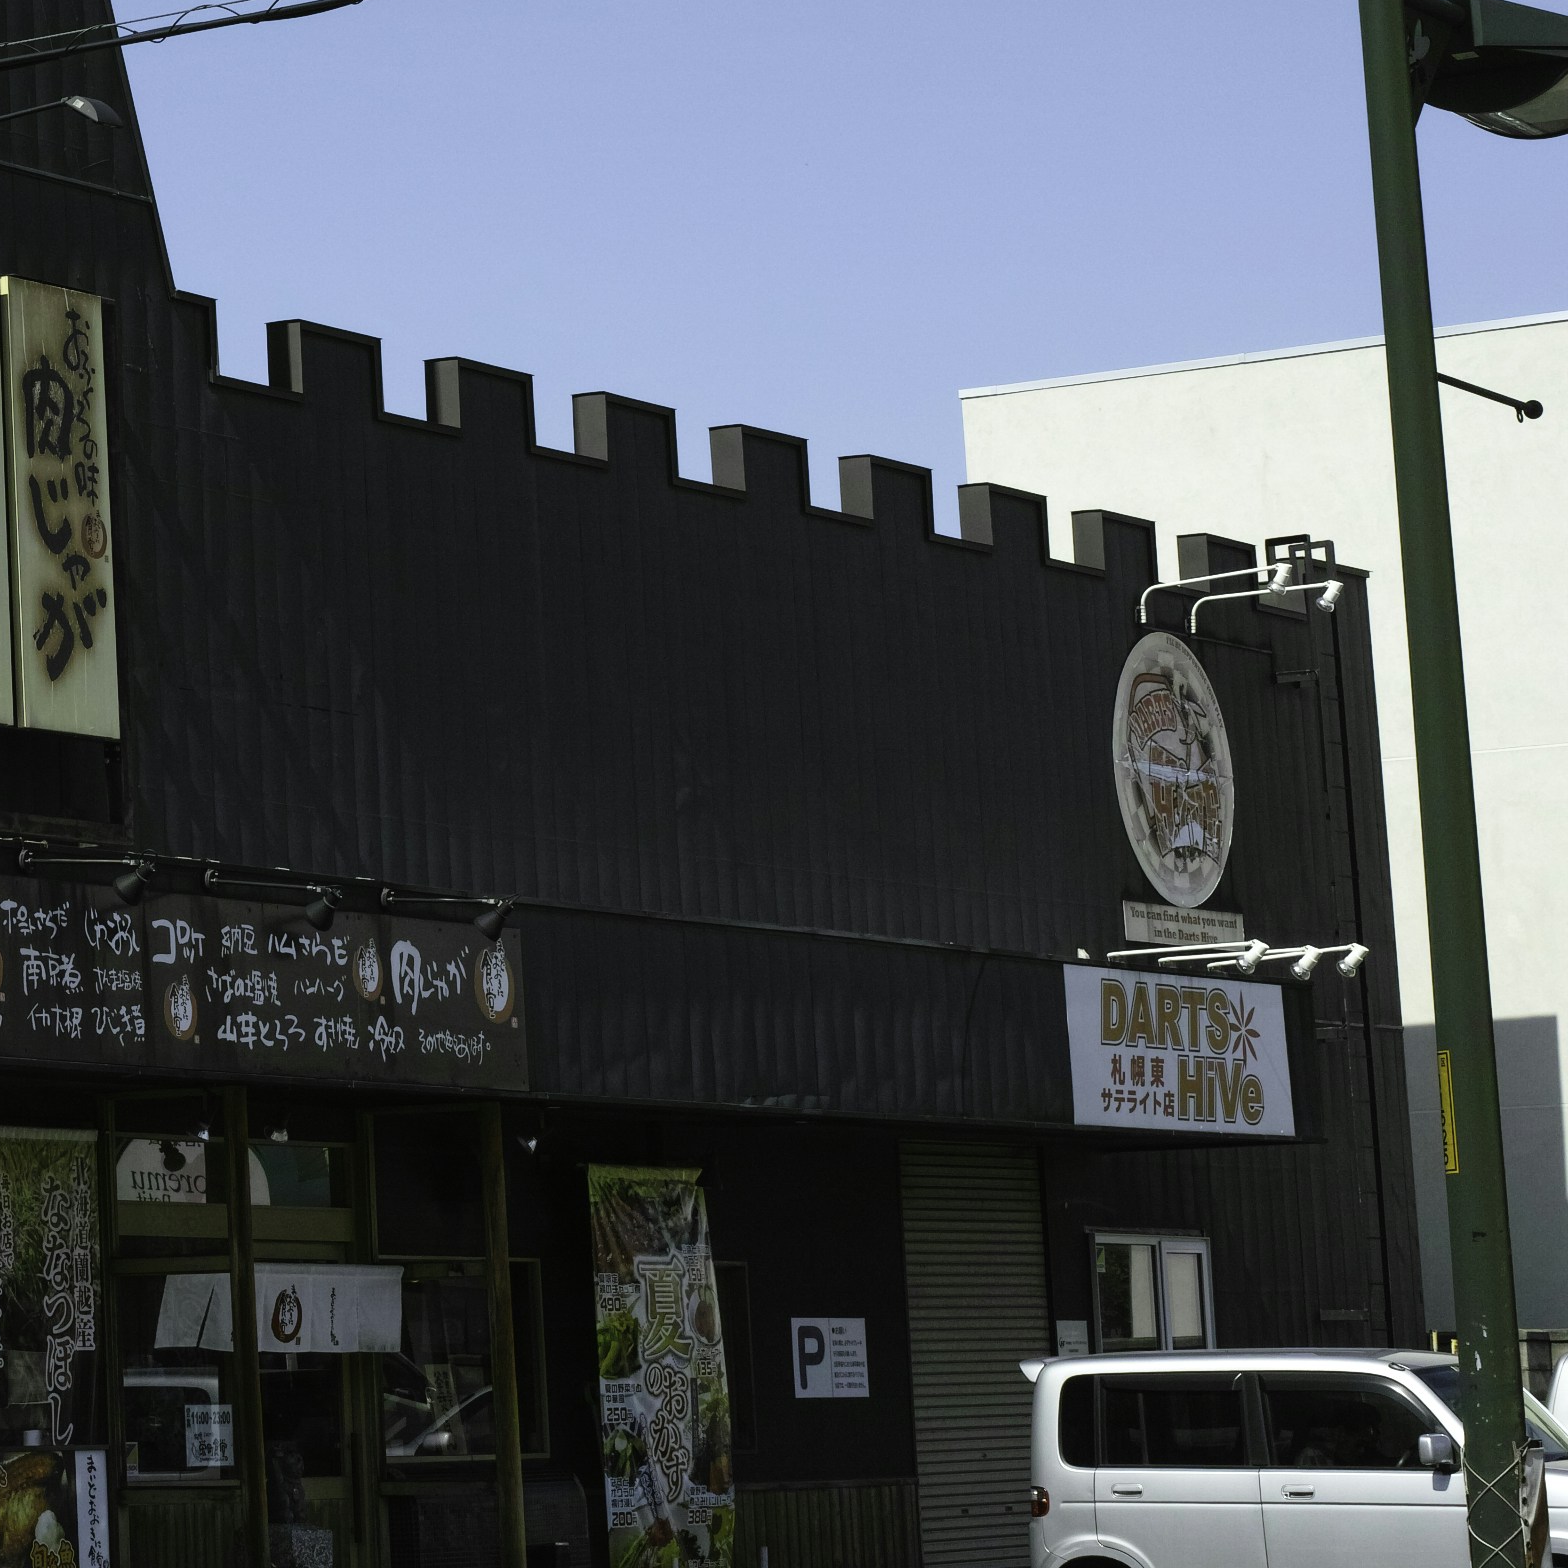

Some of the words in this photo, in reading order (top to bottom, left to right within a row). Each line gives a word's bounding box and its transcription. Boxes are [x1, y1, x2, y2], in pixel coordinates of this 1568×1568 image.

[22, 355, 108, 682] 肉じゃが
[1130, 906, 1145, 919] You
[1147, 912, 1162, 921] can
[1163, 910, 1179, 923] find
[1180, 913, 1201, 925] what
[1202, 917, 1216, 929] you
[1217, 918, 1238, 929] want
[1154, 927, 1163, 938] in
[1163, 928, 1177, 939] the
[1178, 929, 1200, 942] Darts
[152, 919, 206, 965] コロッケ
[221, 924, 258, 958] 納豆
[390, 939, 470, 1017] 肉じゃが
[205, 967, 282, 1006] さばの塩焼
[26, 1003, 82, 1039] イカ大根
[313, 1013, 360, 1053] すき焼
[369, 1014, 406, 1064] 冷奴
[1101, 978, 1231, 1055] DARTS
[1111, 1054, 1165, 1087] 札幌東
[1101, 1088, 1174, 1117] サテライト店
[42, 1176, 76, 1446] ななつぼし
[797, 1325, 825, 1390] P
